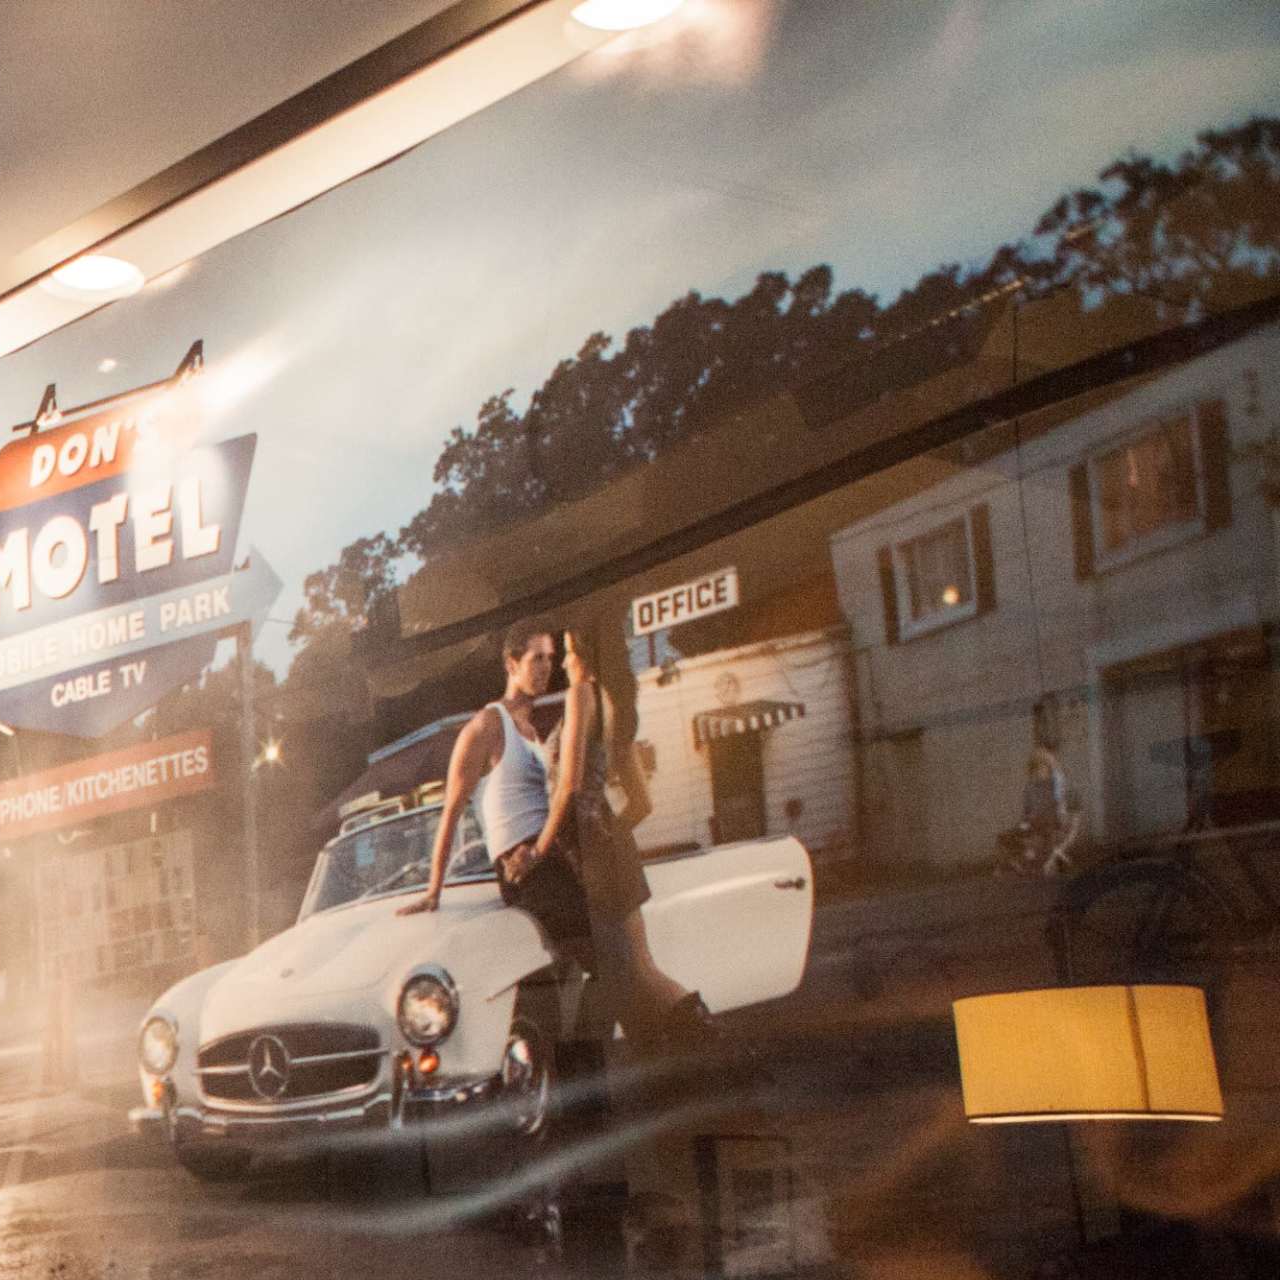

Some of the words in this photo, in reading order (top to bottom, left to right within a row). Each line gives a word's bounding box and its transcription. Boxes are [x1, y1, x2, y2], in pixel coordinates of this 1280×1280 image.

[29, 419, 140, 488] DON'
[71, 611, 145, 656] HOME
[160, 586, 231, 631] PARK
[639, 576, 727, 628] OFFICE
[51, 670, 112, 707] CABLE
[120, 661, 146, 688] TV
